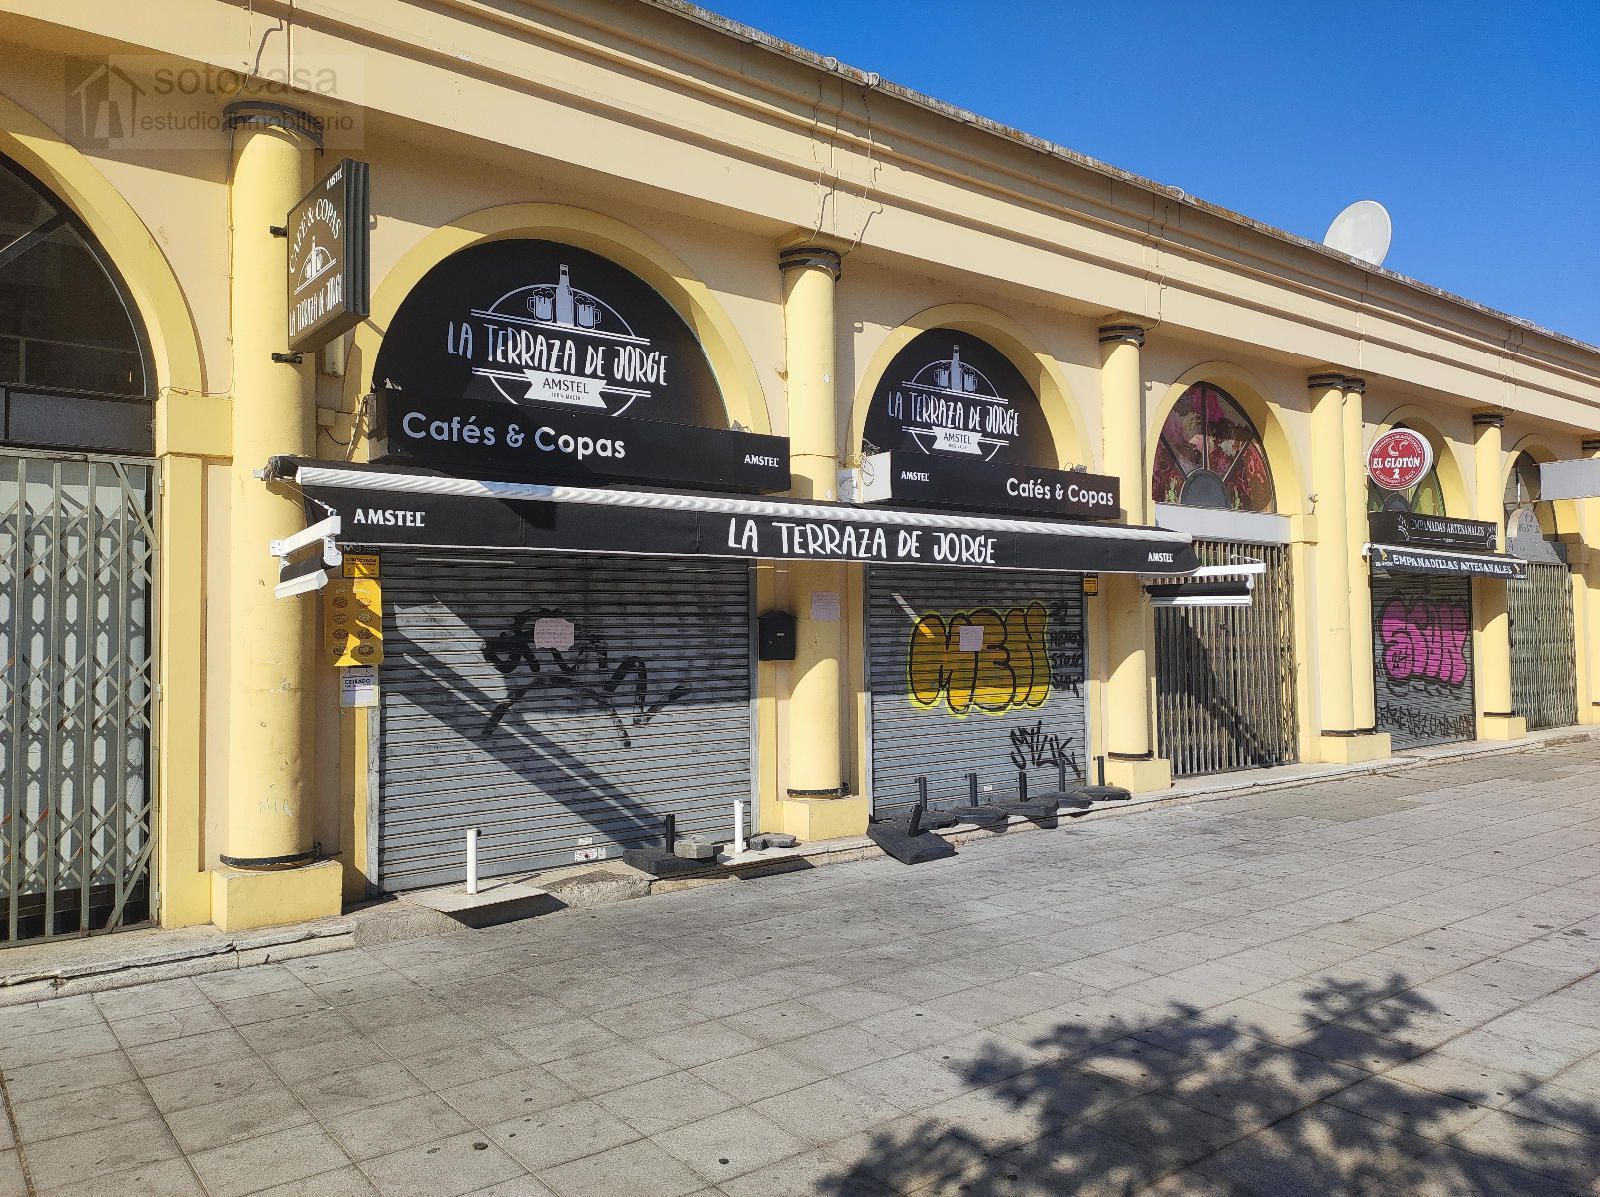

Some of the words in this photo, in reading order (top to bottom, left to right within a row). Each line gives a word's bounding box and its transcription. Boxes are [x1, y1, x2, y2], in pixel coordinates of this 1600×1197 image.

[315, 198, 342, 239] COPAS
[447, 320, 473, 360] LA
[482, 323, 577, 375] TERRAZA
[584, 344, 607, 377] DE
[613, 345, 668, 386] JORGE
[542, 377, 590, 394] AMSTEL
[887, 390, 903, 421] LA
[908, 391, 964, 430] TERRAZA
[968, 406, 982, 431] DE
[985, 405, 1020, 437] JORGE
[402, 411, 496, 446] Cafés
[506, 423, 525, 447] &
[534, 426, 626, 460] Copas
[943, 431, 972, 445] AMSTEL
[743, 454, 780, 468] AMSTEL
[1372, 457, 1384, 469] EL
[900, 470, 930, 482] AMSTEL
[1392, 468, 1400, 480] 2
[1006, 477, 1051, 500] Cafés
[1054, 483, 1064, 500] &
[1067, 484, 1114, 507] Copas
[352, 508, 426, 527] AMSTEL
[1446, 522, 1485, 537] ARTESANALES
[727, 517, 759, 553] LA
[771, 521, 887, 559] TERRAZA
[897, 529, 923, 558] DE
[931, 532, 998, 564] JORGE
[1147, 551, 1174, 563] AMSTEL
[1392, 554, 1459, 570] EMPANADILLAS
[1460, 561, 1513, 575] ARTESANALES
